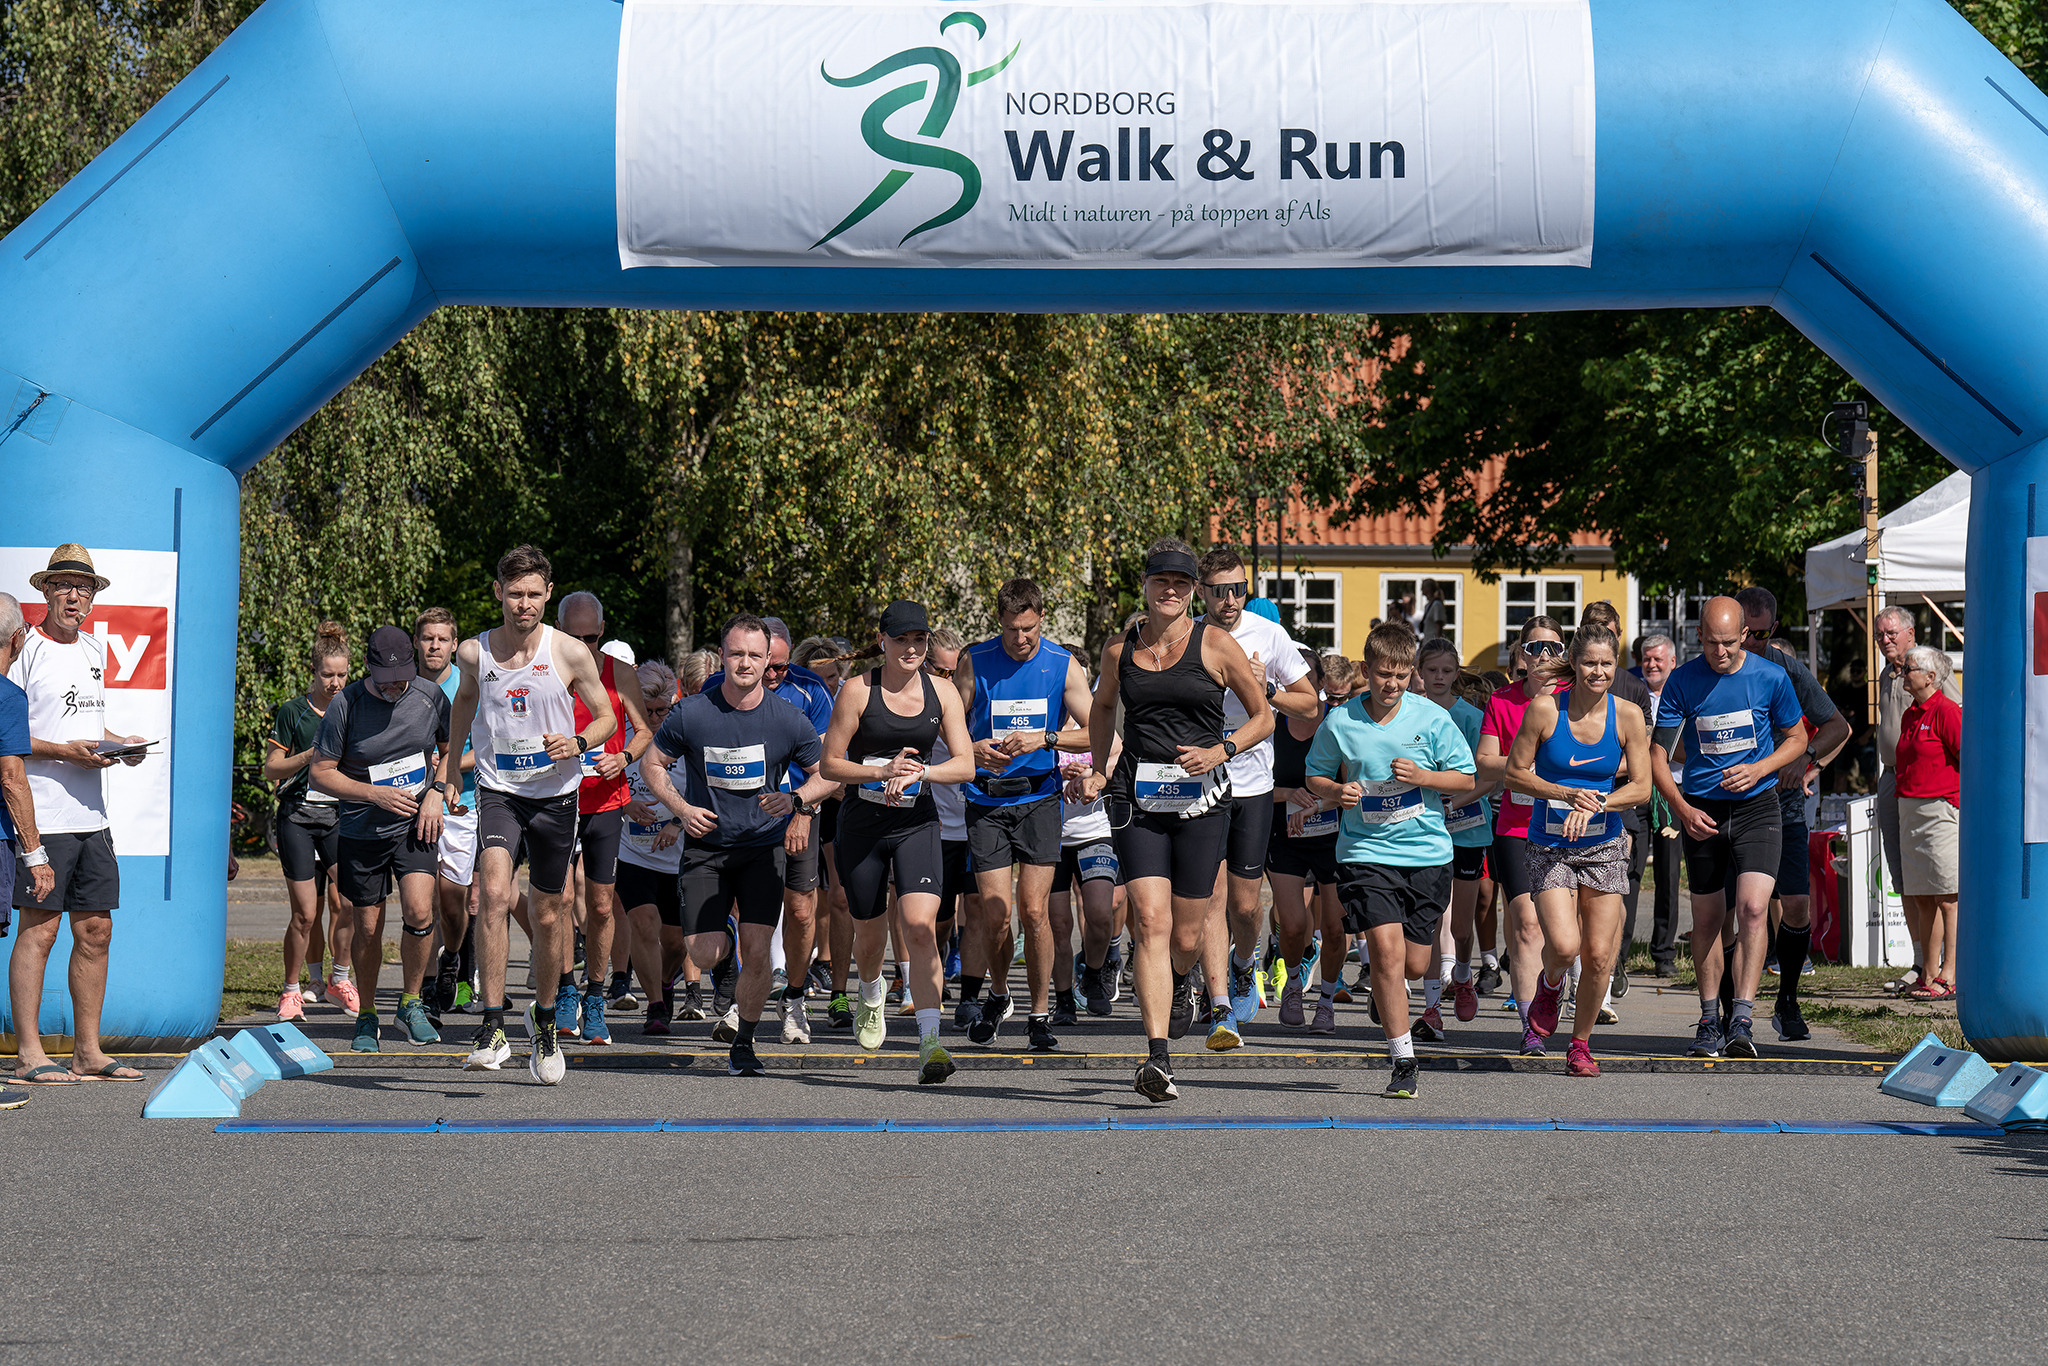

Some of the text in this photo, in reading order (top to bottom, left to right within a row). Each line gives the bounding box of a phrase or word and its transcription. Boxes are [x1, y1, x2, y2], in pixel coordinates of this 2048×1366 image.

[1006, 92, 1175, 115] NORDBORG
[1004, 127, 1405, 182] Walk & Run
[1008, 201, 1056, 222] Midt
[1062, 203, 1067, 222] i
[1073, 204, 1151, 222] naturen
[1171, 203, 1195, 227] på
[1201, 203, 1268, 227] toppen
[1275, 199, 1298, 227] af
[1299, 199, 1331, 221] Als
[78, 700, 95, 708] Walk
[1010, 716, 1030, 726] 465
[1716, 729, 1734, 740] 427
[514, 755, 534, 766] 471
[725, 765, 745, 775] 939
[392, 774, 410, 787] 451
[1157, 784, 1180, 795] 435
[1381, 796, 1402, 808] 437
[1448, 808, 1465, 820] 443
[645, 823, 662, 833] 416
[1095, 857, 1110, 865] 407
